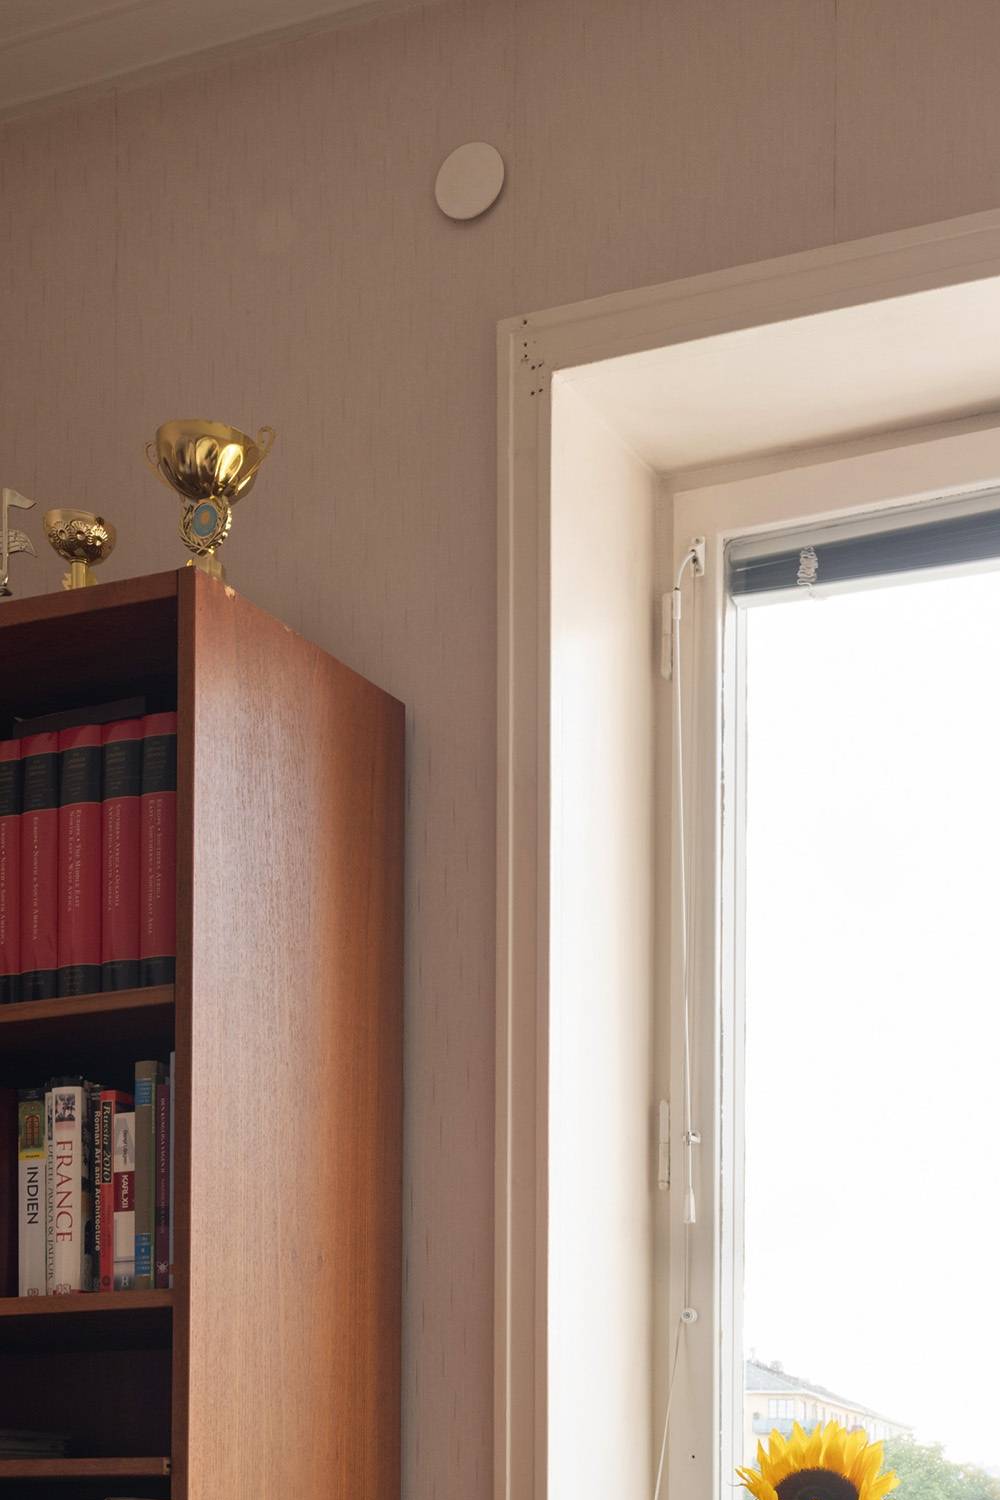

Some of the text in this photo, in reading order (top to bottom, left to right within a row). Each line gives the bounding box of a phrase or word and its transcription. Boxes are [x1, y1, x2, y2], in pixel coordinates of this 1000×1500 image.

[103, 1104, 112, 1182] Russia 2010
[26, 1166, 39, 1225] INDIEN
[55, 1140, 73, 1244] FRANCE
